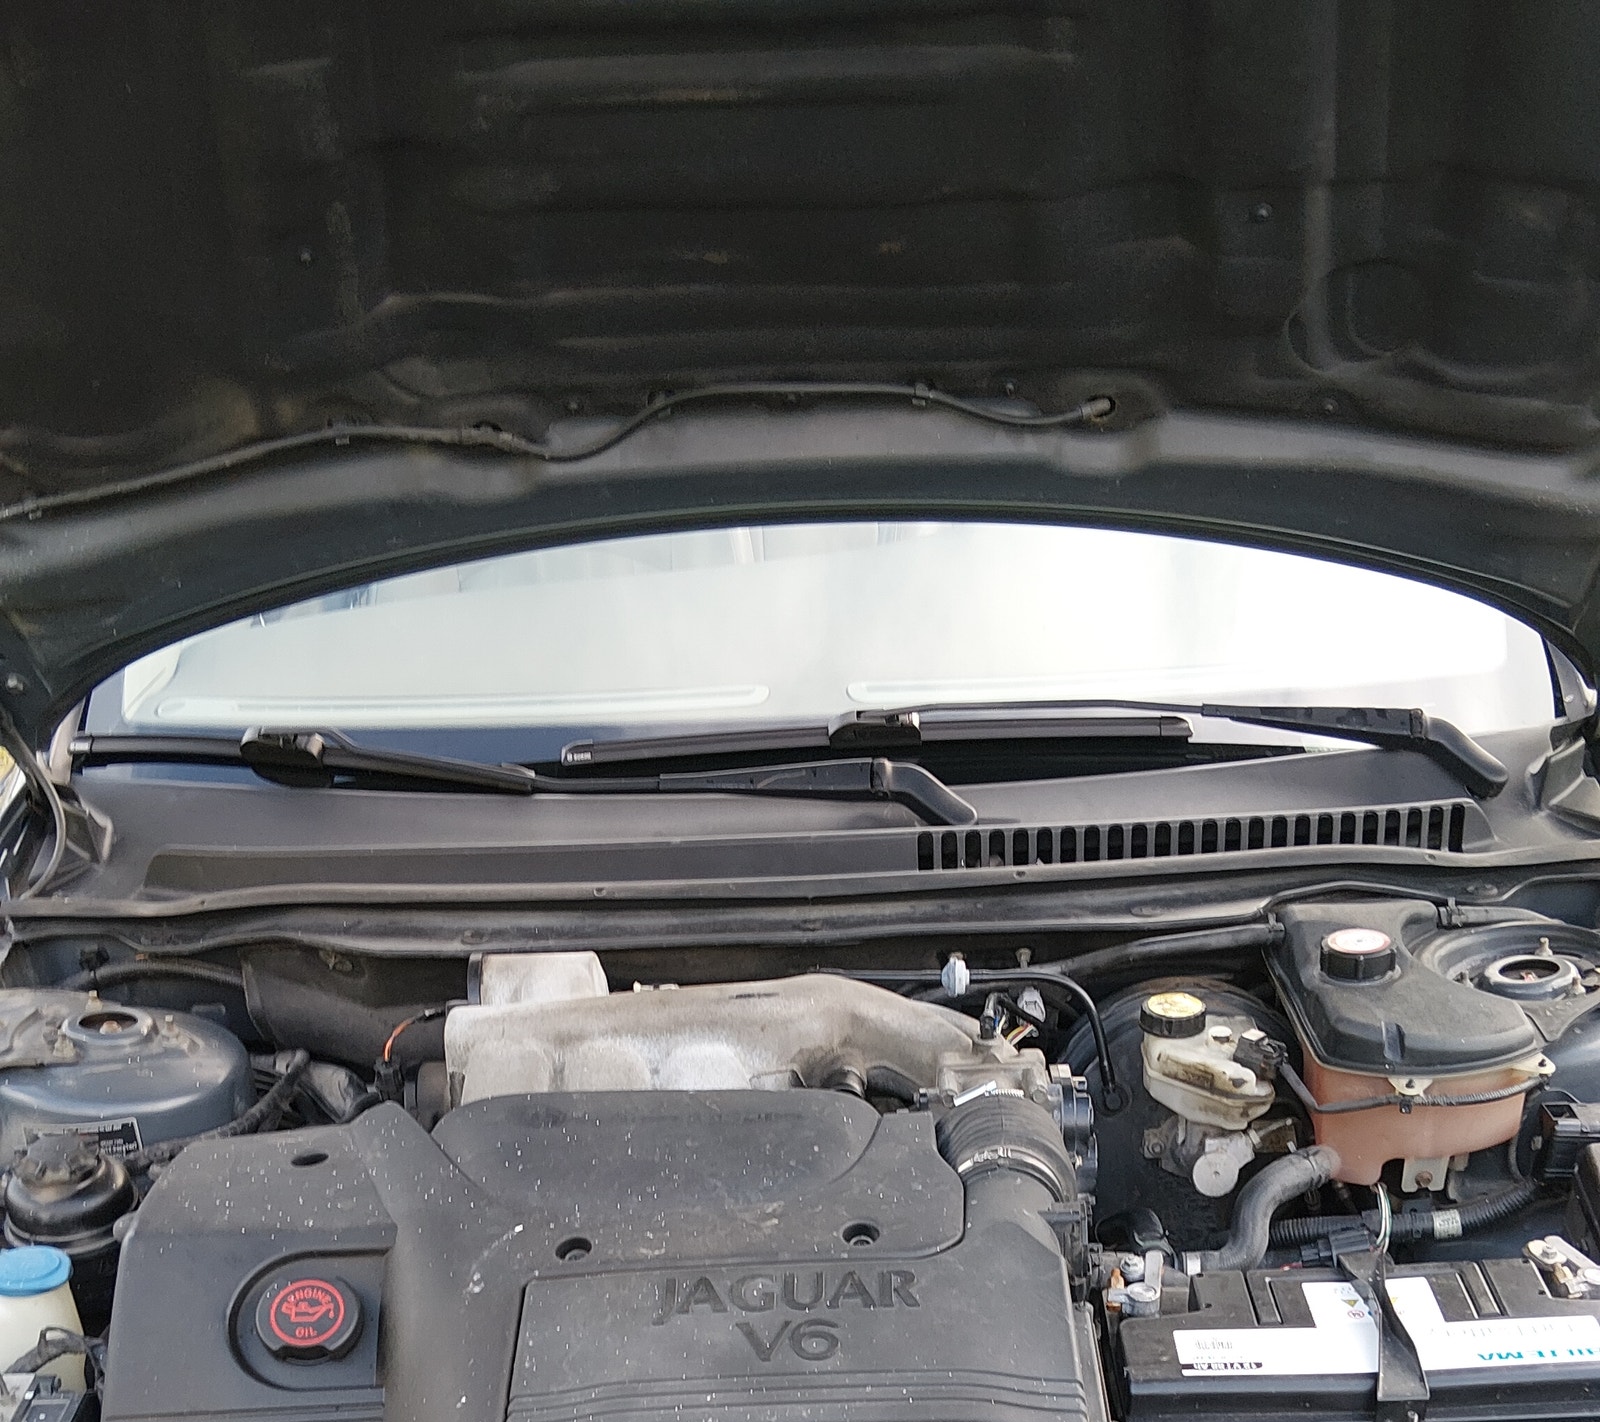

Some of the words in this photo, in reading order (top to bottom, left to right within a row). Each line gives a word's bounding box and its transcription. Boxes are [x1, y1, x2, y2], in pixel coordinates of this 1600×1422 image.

[652, 1269, 921, 1326] JAGUAR
[295, 1326, 318, 1338] OIL
[735, 1318, 841, 1362] V6
